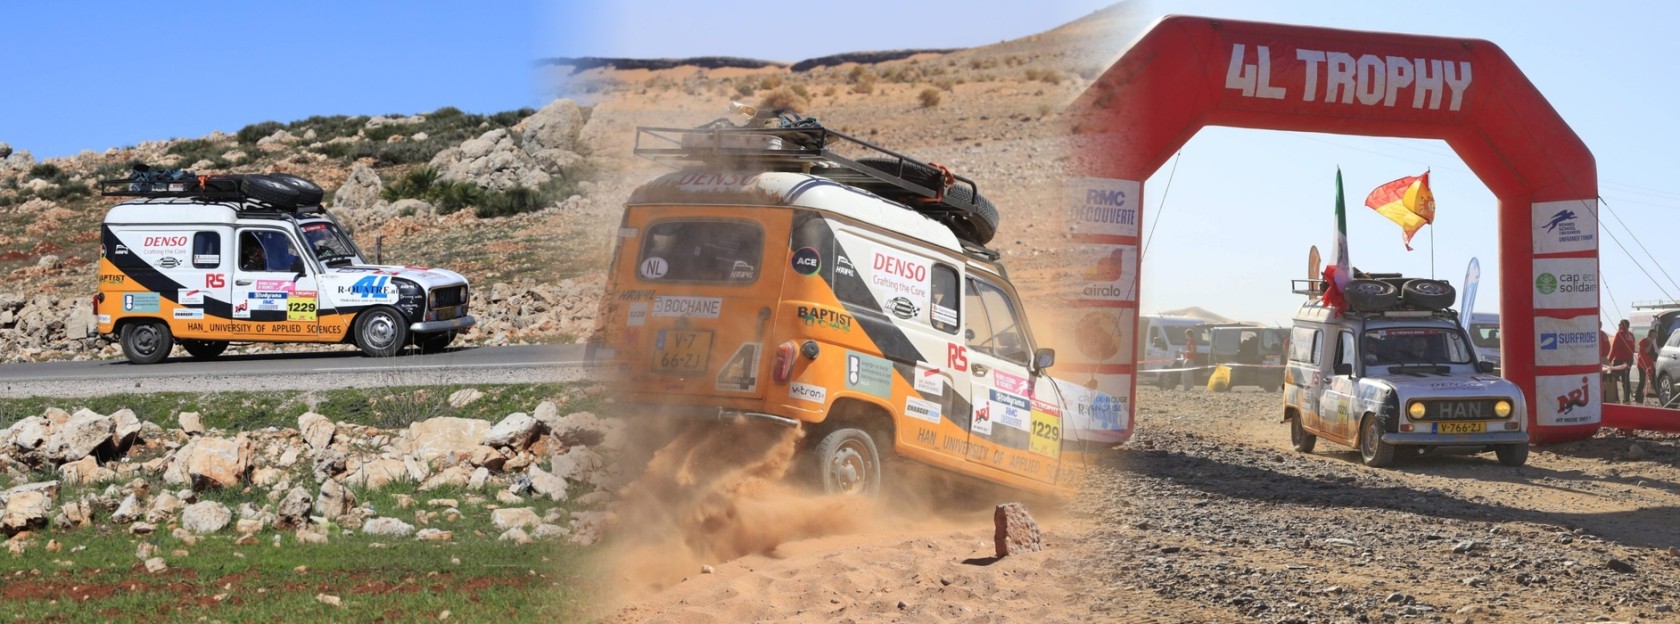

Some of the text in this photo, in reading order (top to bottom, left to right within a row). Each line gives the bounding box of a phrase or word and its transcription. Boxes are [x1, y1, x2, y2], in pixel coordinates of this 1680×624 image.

[1225, 43, 1473, 111] 4L TROPHY
[1086, 188, 1126, 207] RMC
[144, 236, 188, 247] DENSO
[646, 259, 662, 276] NL
[796, 256, 817, 267] ACE
[873, 252, 927, 283] DENSO
[205, 273, 225, 288] RS
[351, 275, 389, 298] 4L
[873, 274, 926, 297] Crafting the Core
[1559, 274, 1580, 283] cap
[1083, 284, 1121, 297] airalo
[234, 299, 248, 313] NRJ
[288, 302, 316, 313] 1229
[664, 298, 721, 315] BOCHANE
[797, 306, 853, 327] BAPTIST
[209, 324, 252, 333] UNIVERSITY
[256, 324, 266, 333] OF
[271, 324, 301, 333] APPLIED
[306, 324, 341, 335] SCIENCES
[660, 352, 701, 369] 66-ZJ
[948, 342, 969, 372] RS
[995, 391, 1026, 410] Studyrama
[1557, 376, 1590, 415] NRJ
[975, 401, 990, 424] NRJ
[1005, 406, 1018, 419] RMC
[1439, 402, 1482, 418] HAN
[1031, 419, 1060, 442] 1229
[1438, 423, 1482, 433] V-766-ZJ
[942, 434, 990, 465] UNIVERSITY
[992, 450, 1004, 465] OF
[1009, 455, 1041, 477] APPLIED
